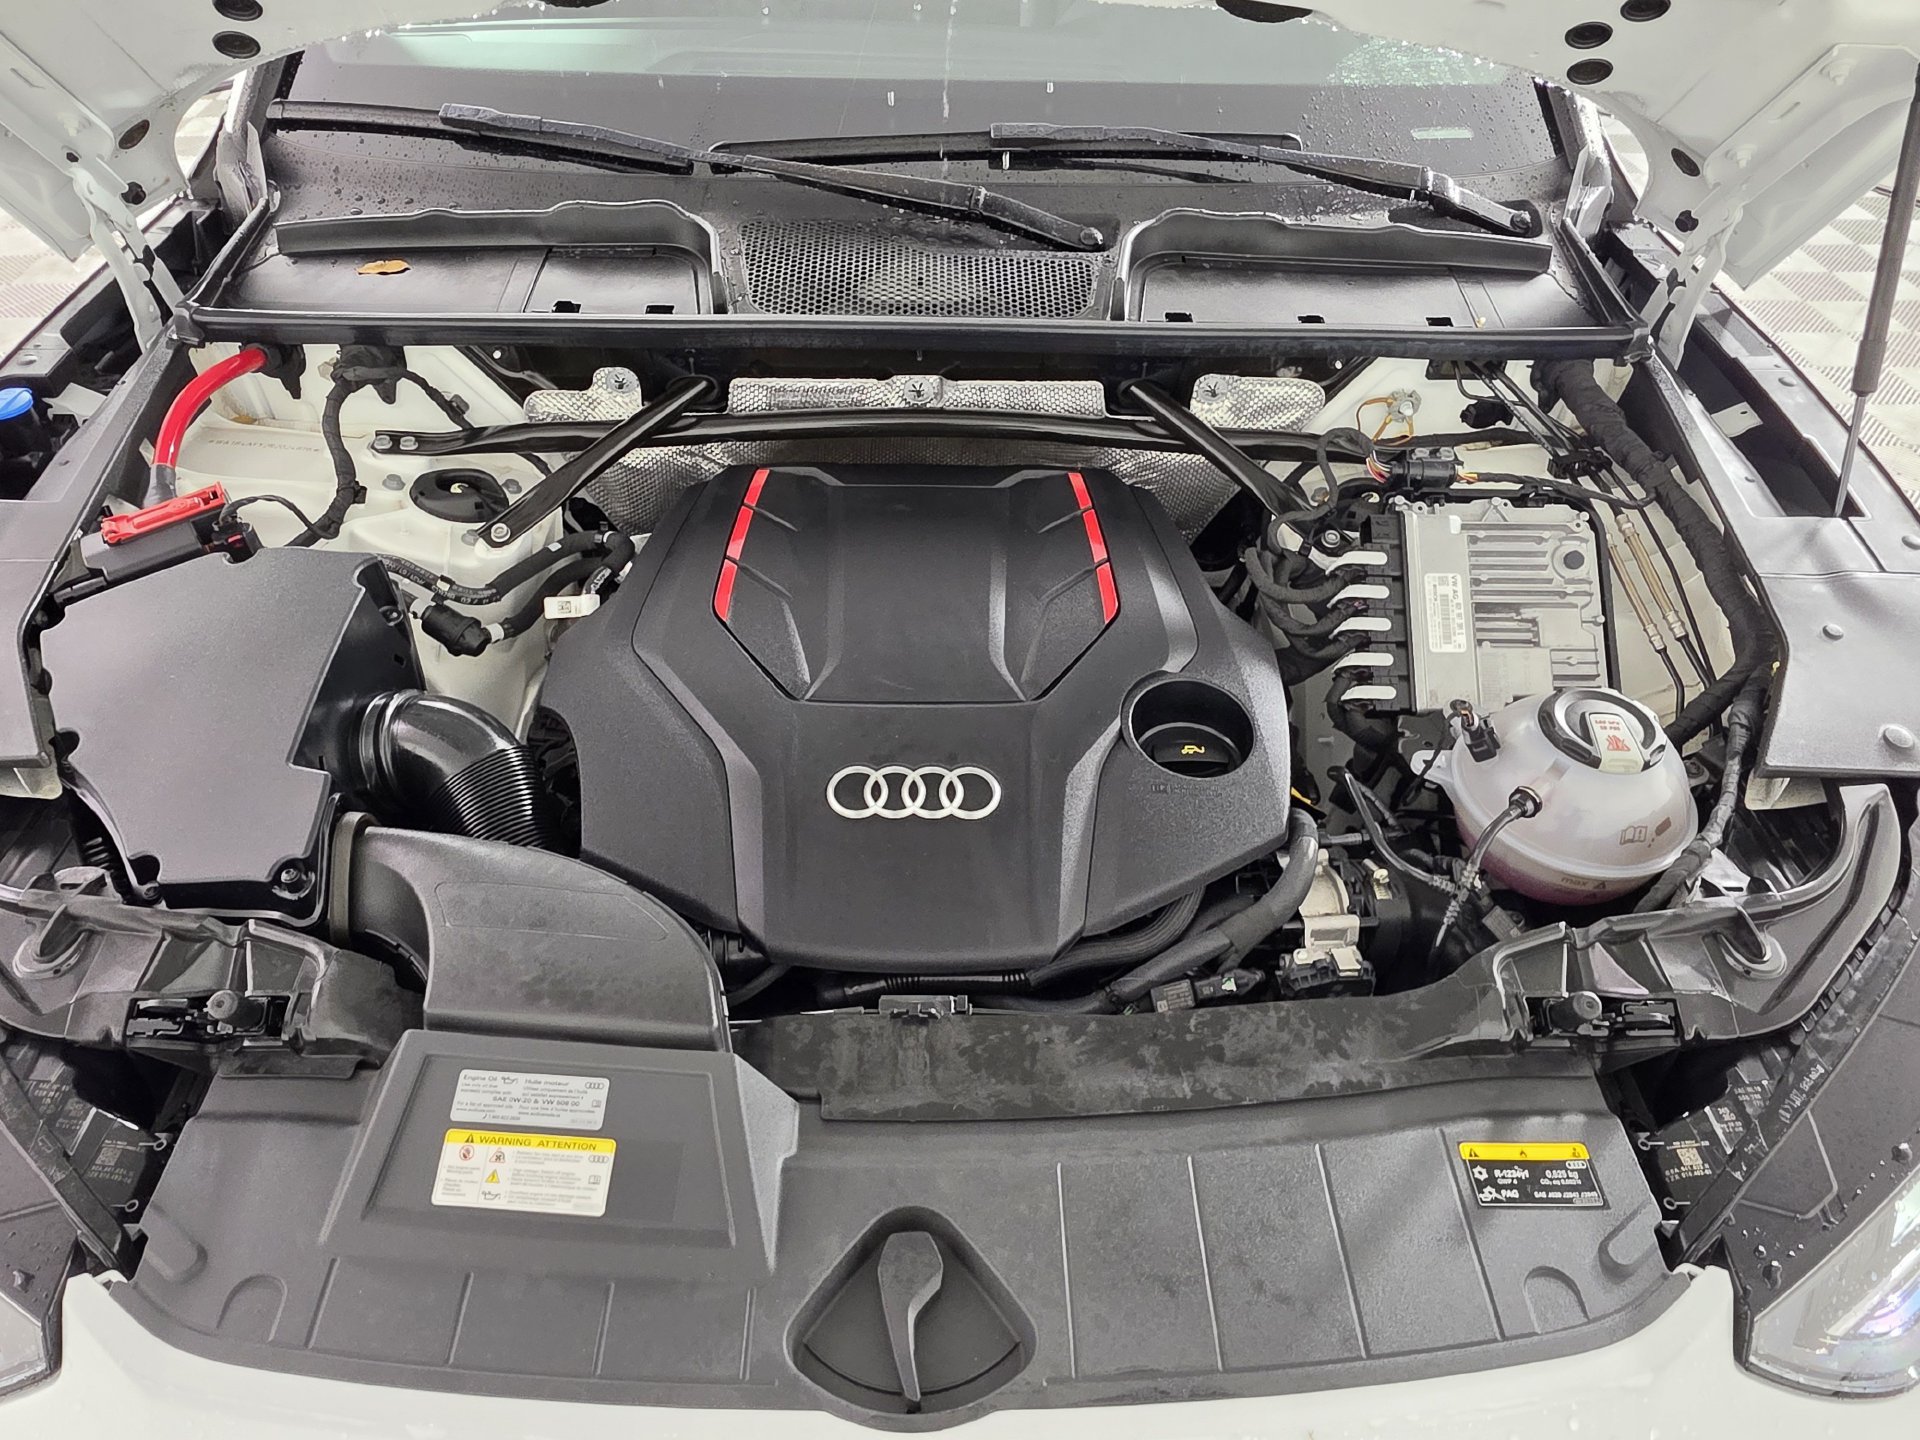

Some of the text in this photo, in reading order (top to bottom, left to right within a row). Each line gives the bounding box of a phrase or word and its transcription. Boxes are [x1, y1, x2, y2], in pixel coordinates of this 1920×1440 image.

[1450, 575, 1457, 587] VW
[1561, 876, 1589, 887] max
[463, 1074, 498, 1083] Engine Oil
[524, 1078, 570, 1087] Huile moteur
[508, 1096, 532, 1104] 0W-20
[479, 1135, 598, 1151] WARNING ATTENTION
